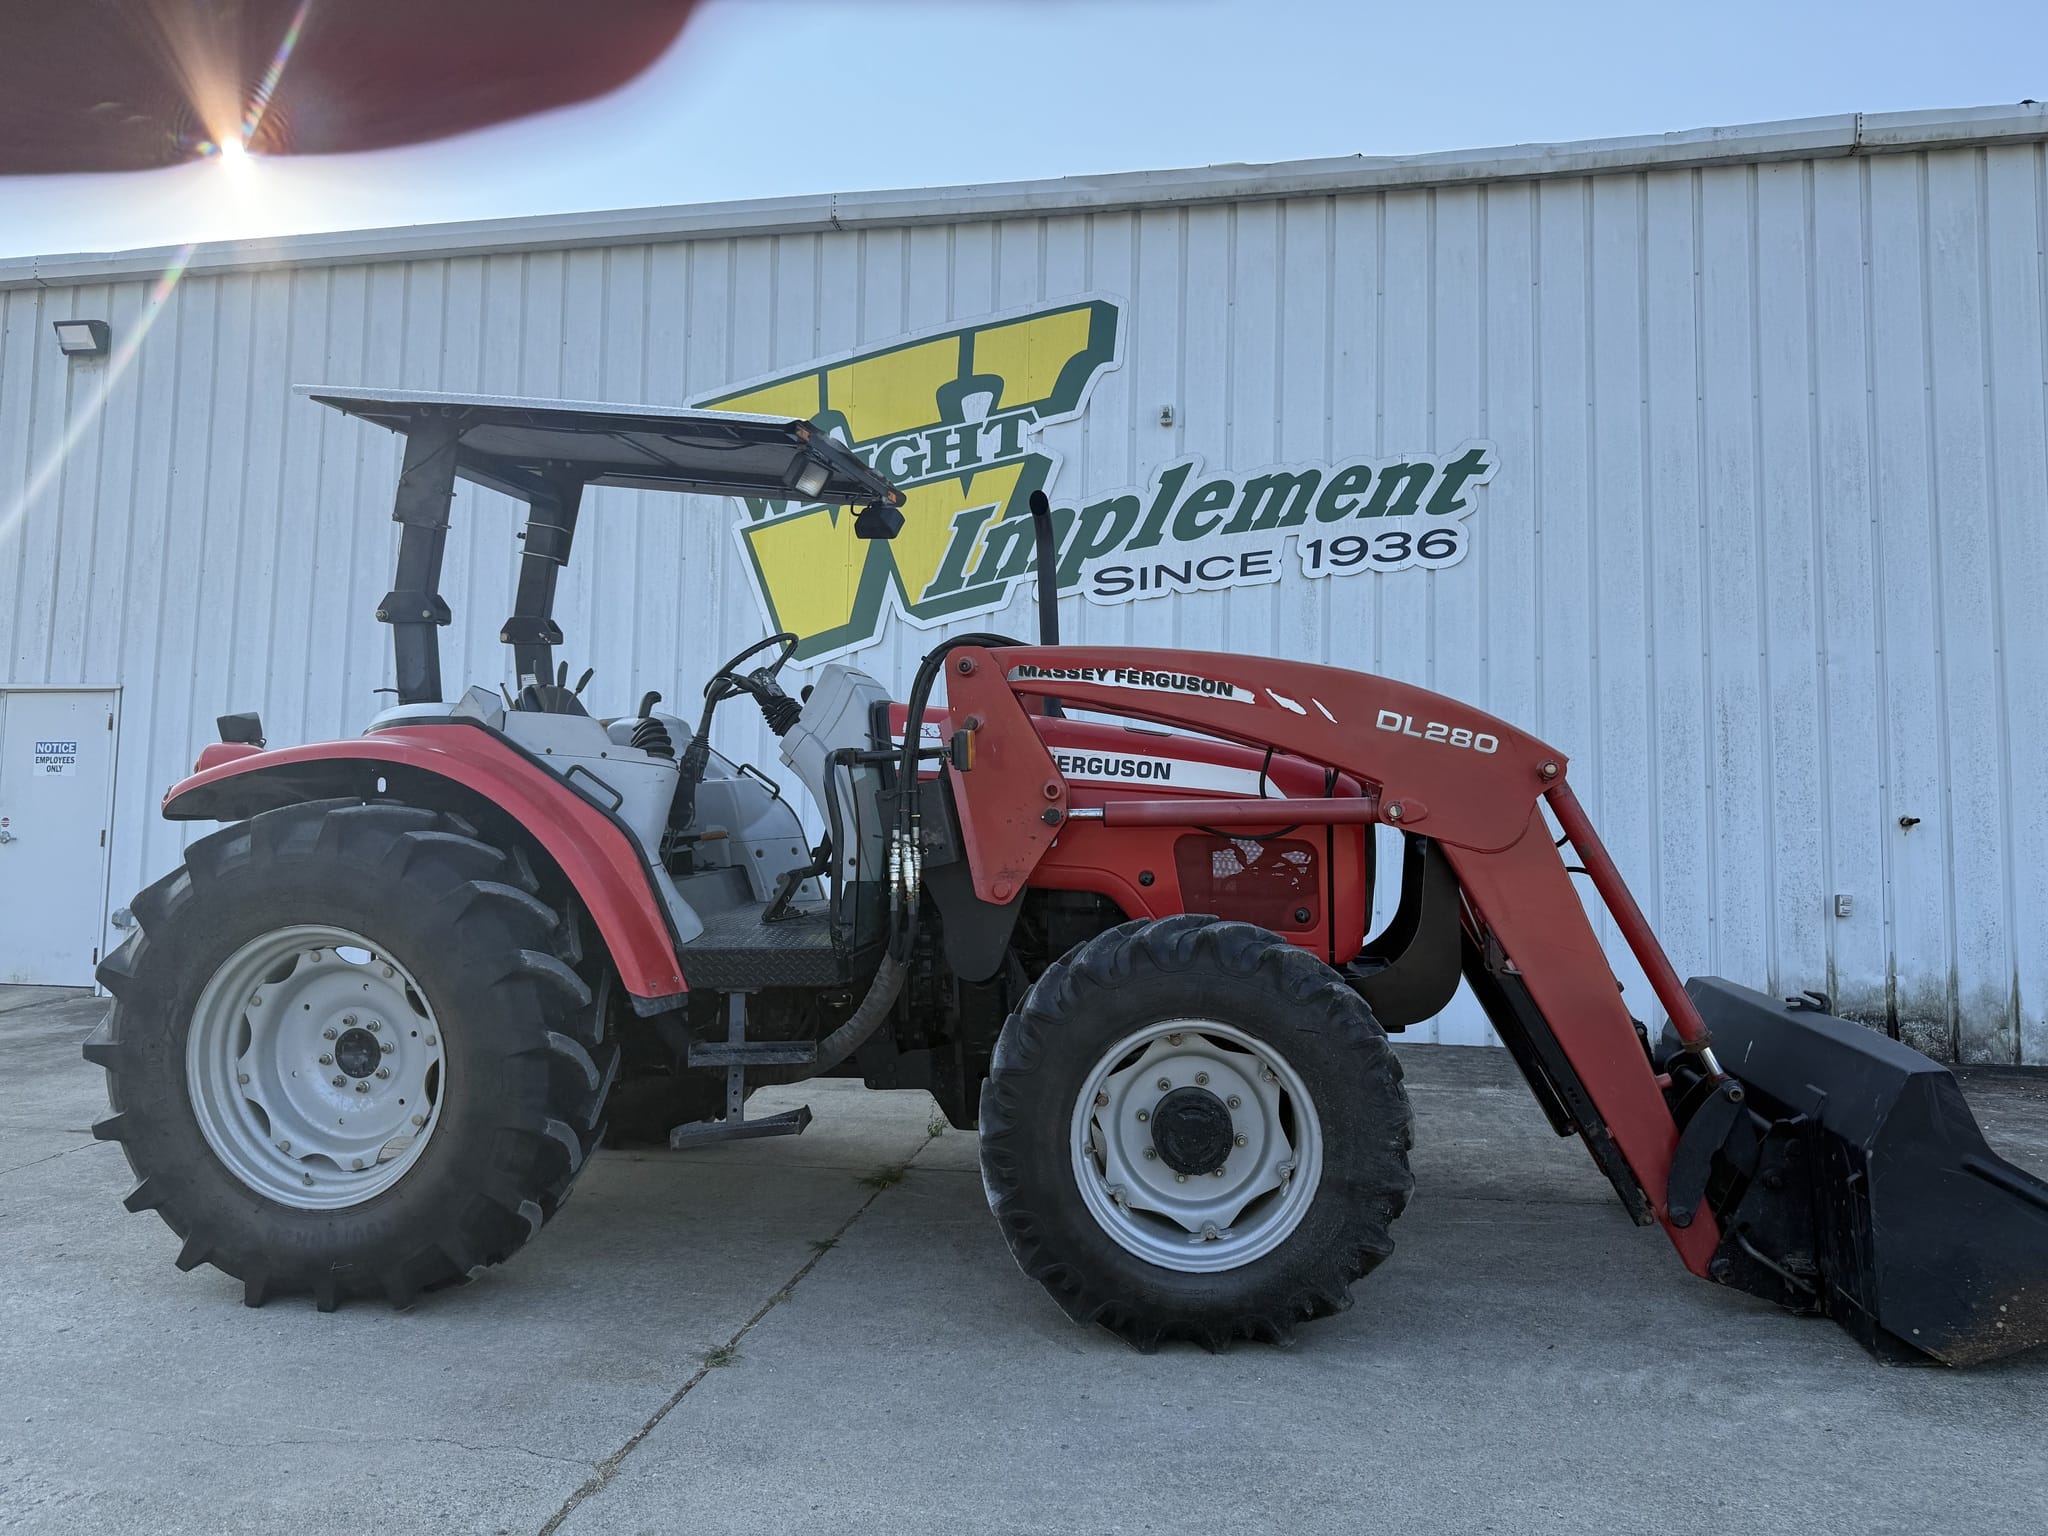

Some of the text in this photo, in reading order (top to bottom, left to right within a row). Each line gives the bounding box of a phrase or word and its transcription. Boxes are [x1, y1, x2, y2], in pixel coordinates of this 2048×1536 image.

[922, 449, 1488, 599] Implement
[1093, 529, 1458, 597] SINCE 1936
[1017, 664, 1234, 697] MASSEY FERGUSON
[1375, 709, 1499, 754] DL280
[35, 756, 75, 764] EMPLOYEES
[36, 743, 76, 753] NOTICE
[46, 765, 63, 773] ONLY
[1053, 754, 1171, 780] ERGUSON
